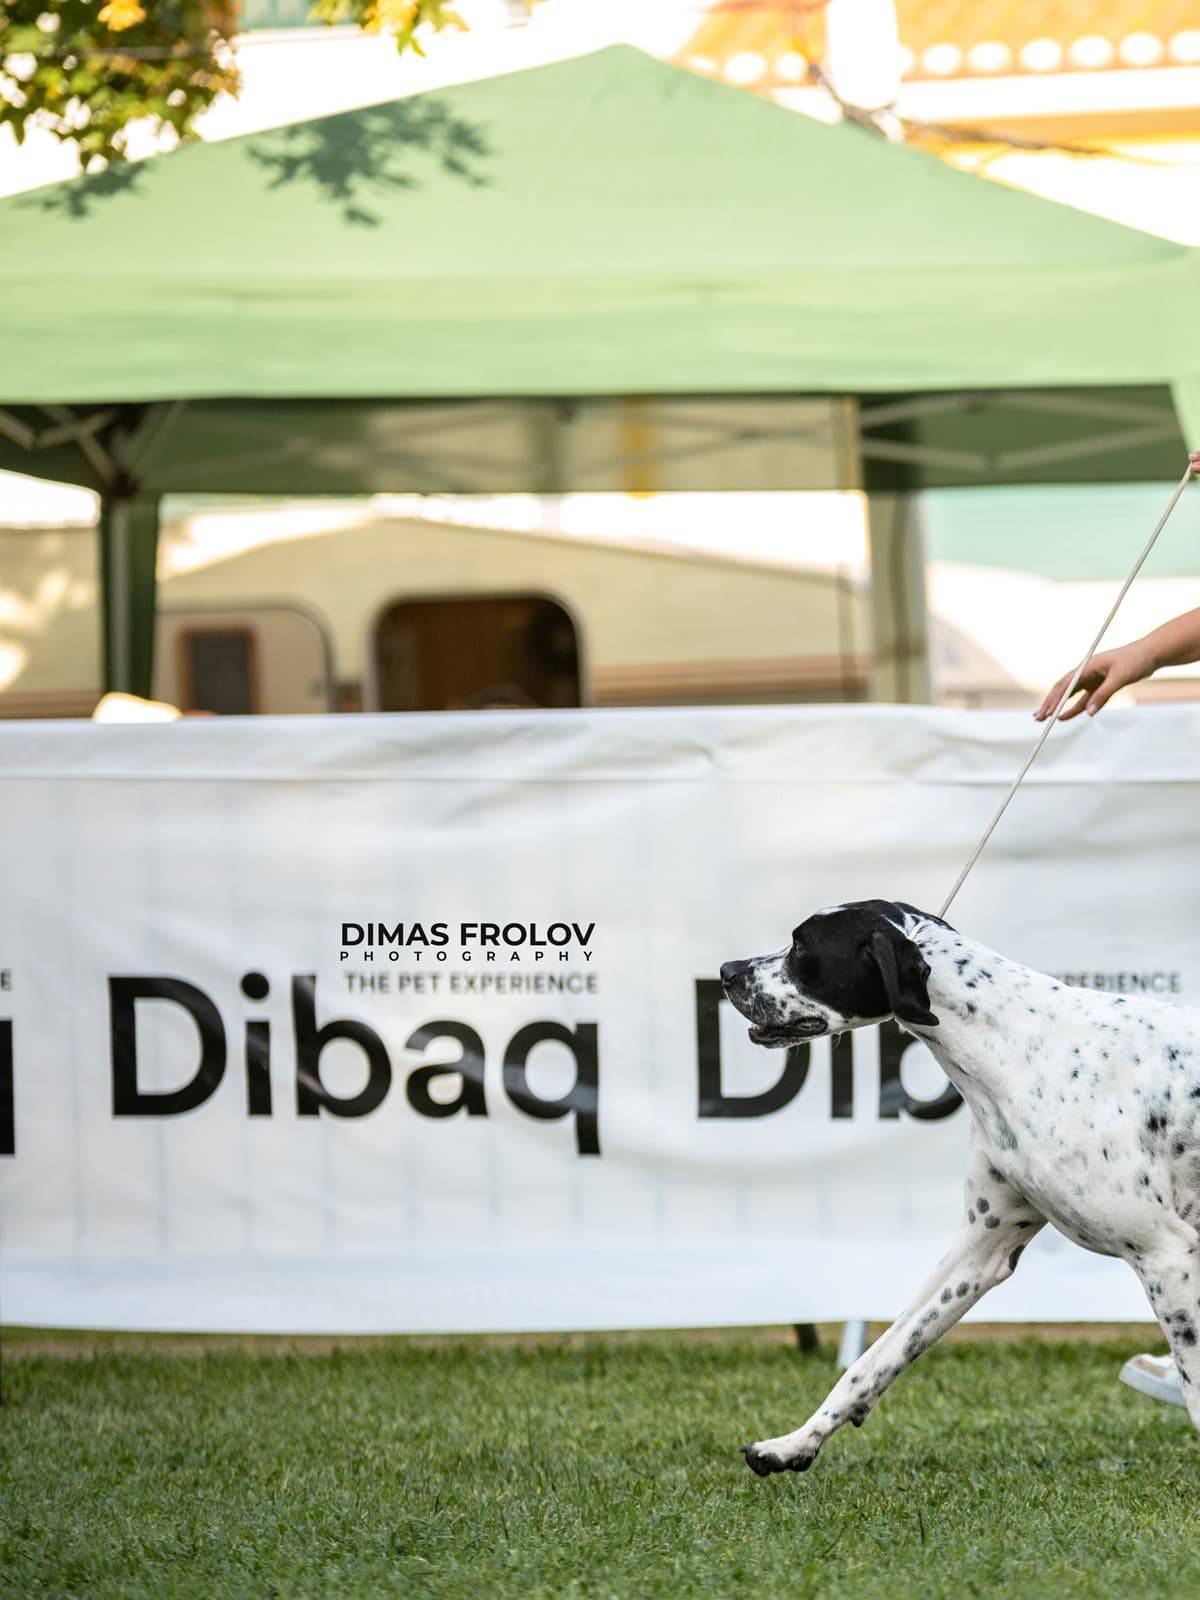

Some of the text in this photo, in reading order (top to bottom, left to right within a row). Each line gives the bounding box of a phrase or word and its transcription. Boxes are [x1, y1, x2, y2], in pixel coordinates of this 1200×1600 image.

[344, 971, 599, 995] THE PET EXPERIENCE
[1056, 971, 1182, 993] PERIENCE
[108, 971, 602, 1157] Dibaq
[694, 978, 964, 1120] Dib
